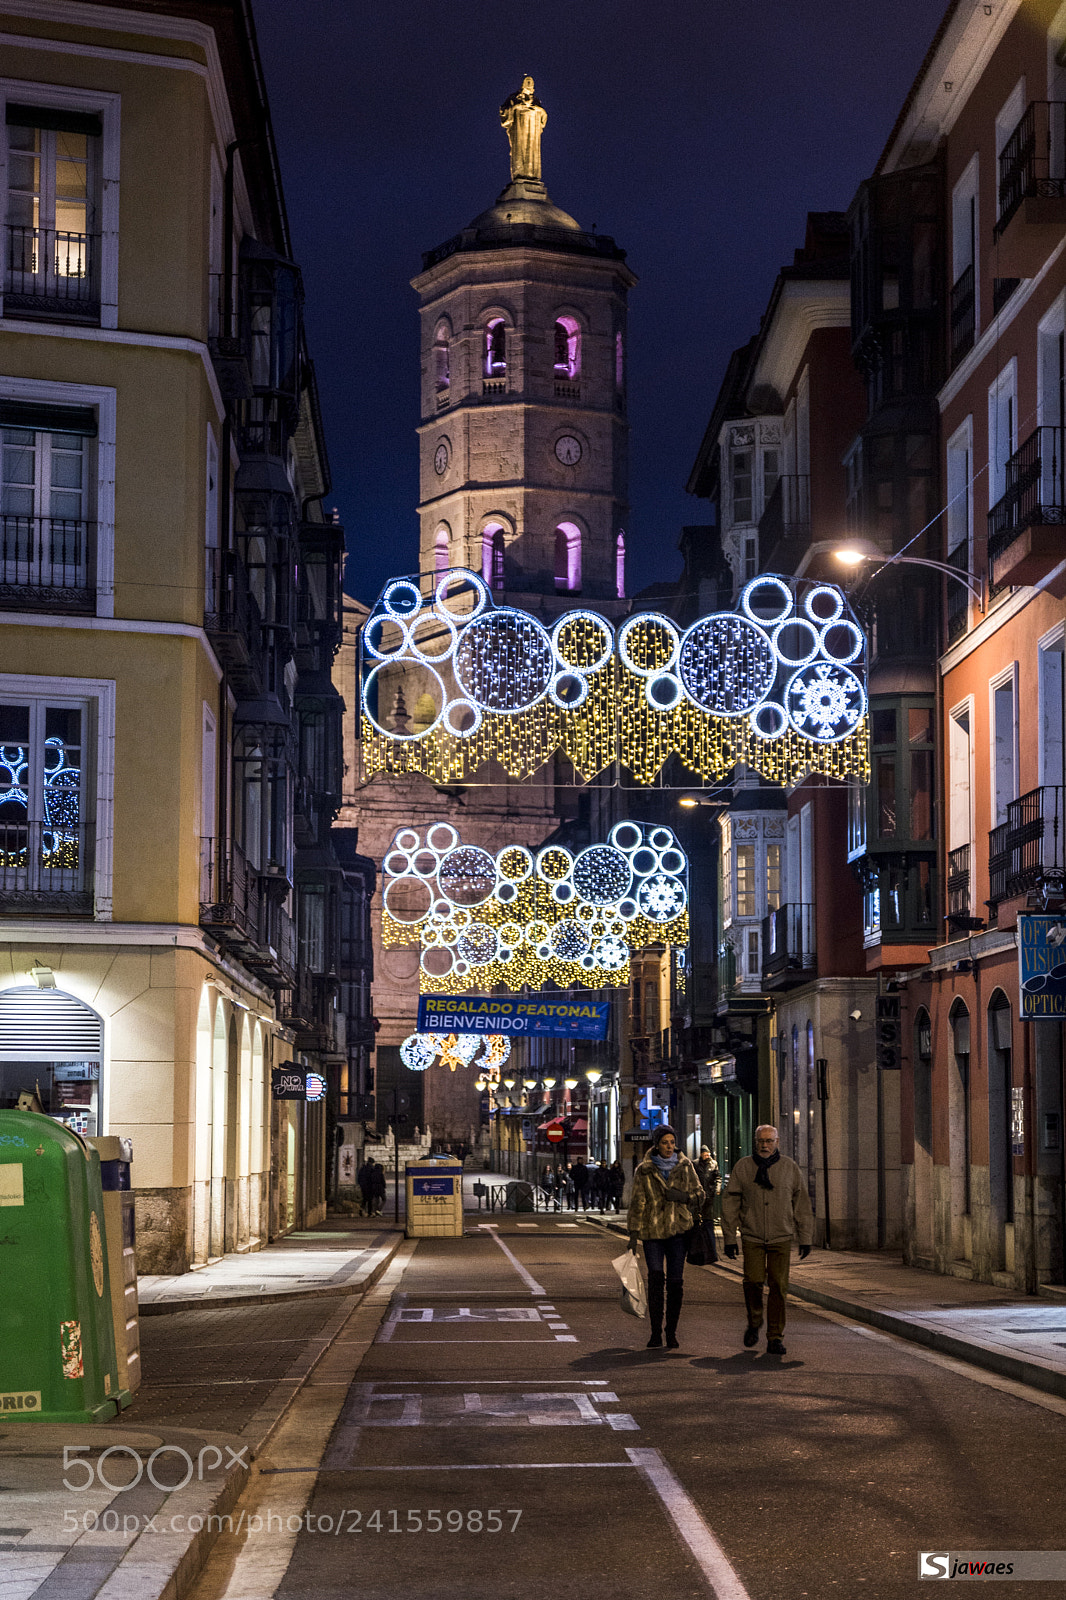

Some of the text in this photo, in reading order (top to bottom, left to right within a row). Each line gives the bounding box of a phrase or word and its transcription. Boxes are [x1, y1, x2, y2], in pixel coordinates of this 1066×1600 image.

[426, 999, 601, 1018] REGALADO PEATONAL
[425, 1015, 528, 1030] ¡BIENVENIDO!
[0, 1395, 37, 1410] RIO
